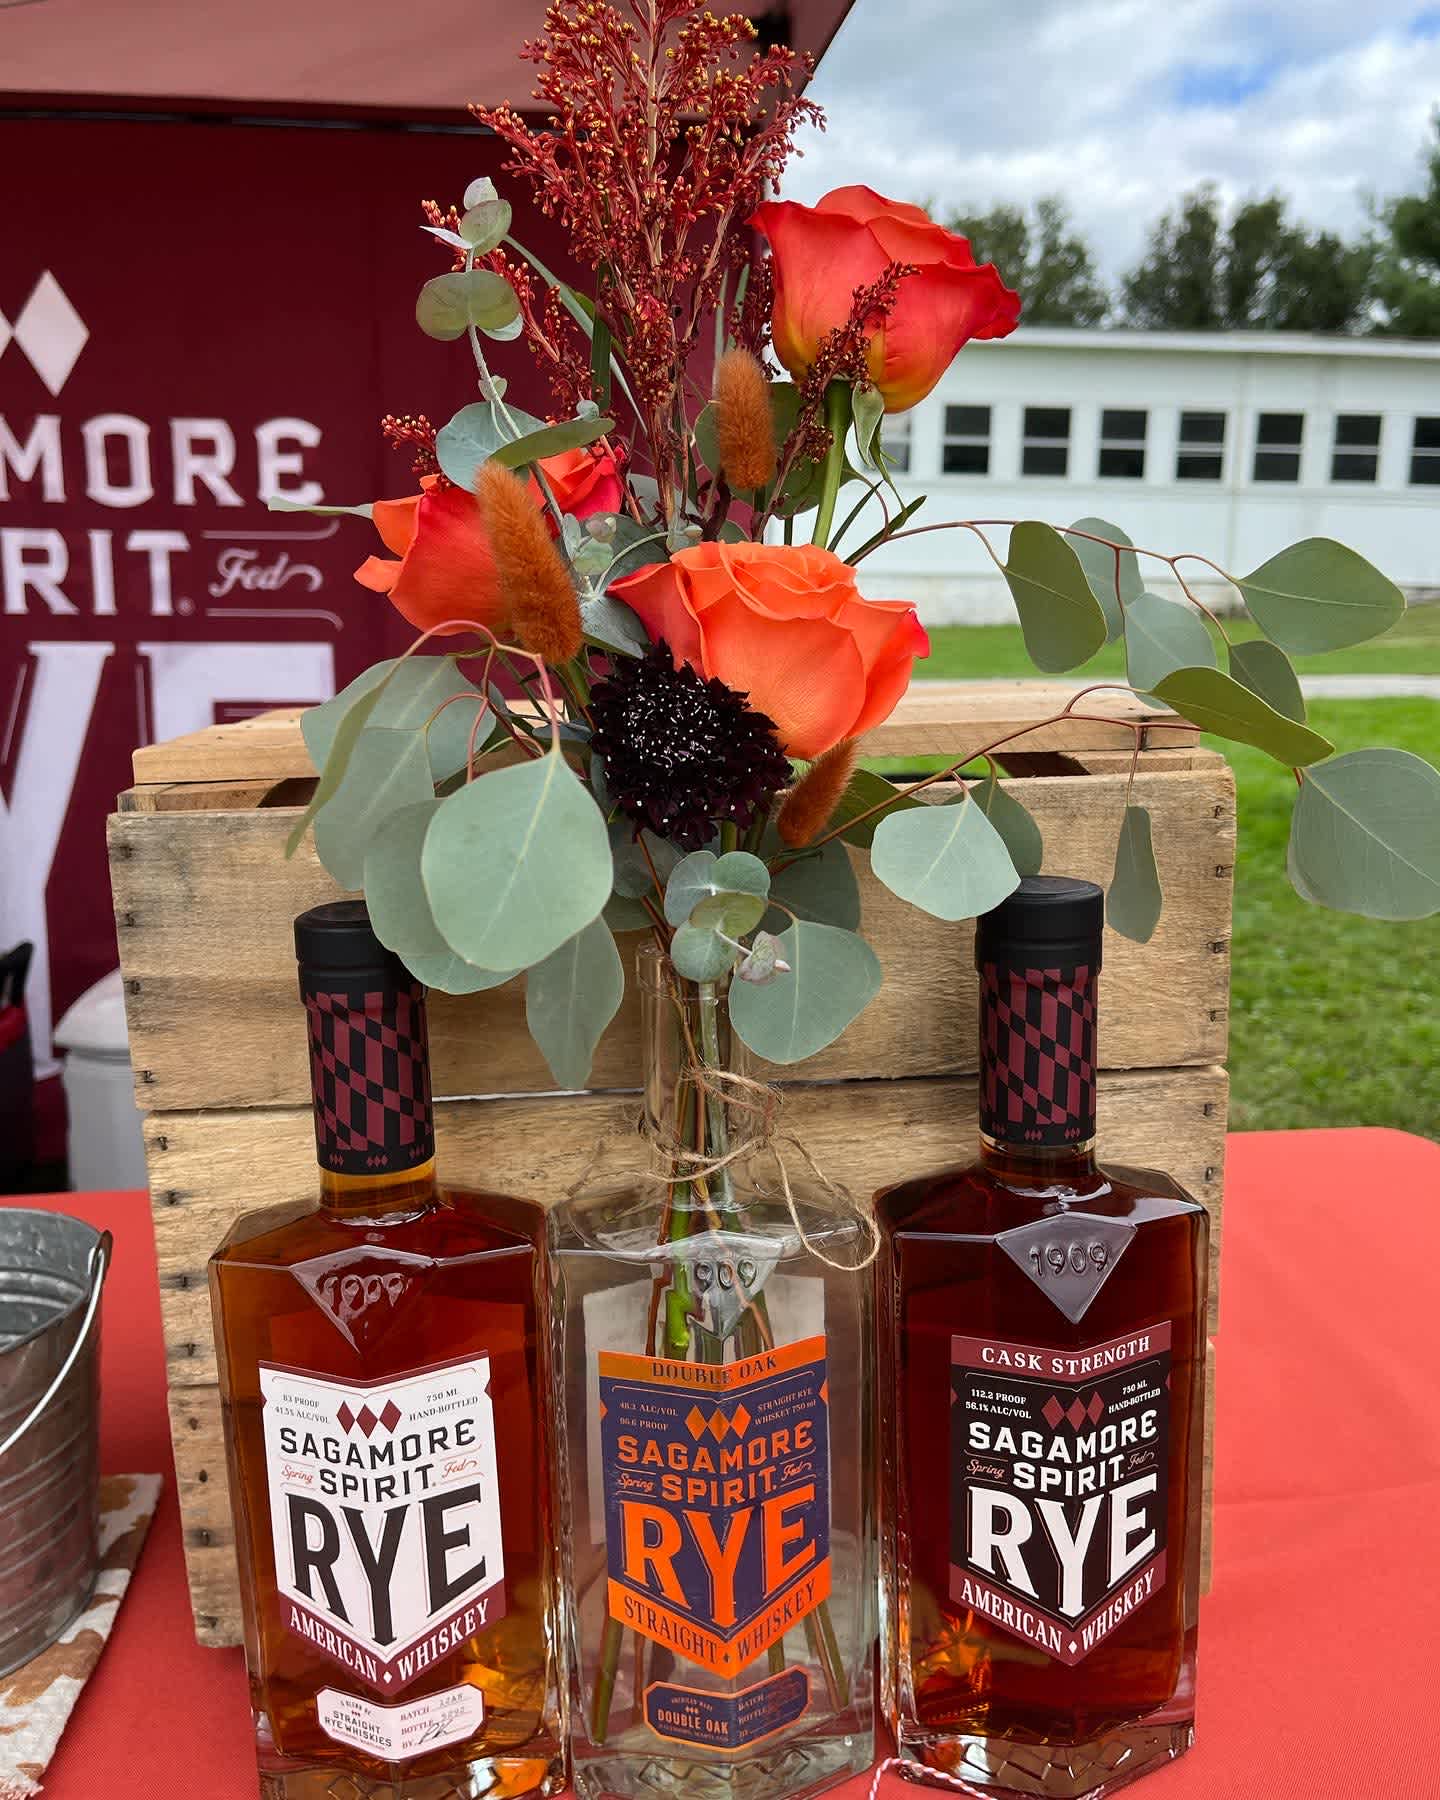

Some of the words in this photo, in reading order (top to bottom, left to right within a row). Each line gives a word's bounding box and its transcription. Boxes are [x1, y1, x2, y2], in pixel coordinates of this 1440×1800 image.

[208, 548, 323, 598] Fed
[1028, 1242, 1108, 1276] 1909
[652, 1361, 732, 1385] DOUBLE
[739, 1355, 777, 1379] OAK
[982, 1347, 1043, 1371] CASK
[1052, 1335, 1150, 1376] STRENGTH
[294, 1396, 319, 1408] PROOF
[971, 1389, 994, 1400] 112.2
[995, 1392, 1027, 1405] PROOF
[1108, 1388, 1161, 1414] HAND-BOTTLED
[1122, 1383, 1136, 1395] 750
[409, 1396, 478, 1421] HAND-BOTTLED
[965, 1401, 989, 1412] 56.1%
[990, 1405, 1032, 1419] ALC/VOL
[639, 1420, 669, 1432] PROOF
[968, 1409, 1158, 1464] SAGAMORE
[280, 1418, 476, 1470] SAGAMORE
[617, 1420, 813, 1474] SAGAMORE
[281, 1464, 313, 1484] Spring
[442, 1460, 478, 1479] Fed
[618, 1472, 655, 1493] Spring
[781, 1462, 812, 1482] Fed
[966, 1459, 1005, 1479] Spring
[1128, 1451, 1155, 1470] Fed
[620, 1483, 816, 1628] RYE
[967, 1473, 1157, 1617] RYE
[285, 1482, 486, 1647] RYE
[624, 1595, 717, 1664] STRAIGHT
[737, 1578, 816, 1662] WHISKEY
[961, 1579, 1063, 1653] AMERICAN
[1082, 1568, 1155, 1650] WHISKEY
[290, 1606, 377, 1683] AMERICAN
[397, 1598, 489, 1681] WHISKEY
[333, 1711, 380, 1734] STRAIGHT
[401, 1704, 430, 1720] BATCH
[657, 1708, 701, 1729] DOUBLE
[706, 1719, 729, 1735] OAK
[325, 1716, 343, 1729] RYE
[345, 1725, 392, 1747] WHISKIES
